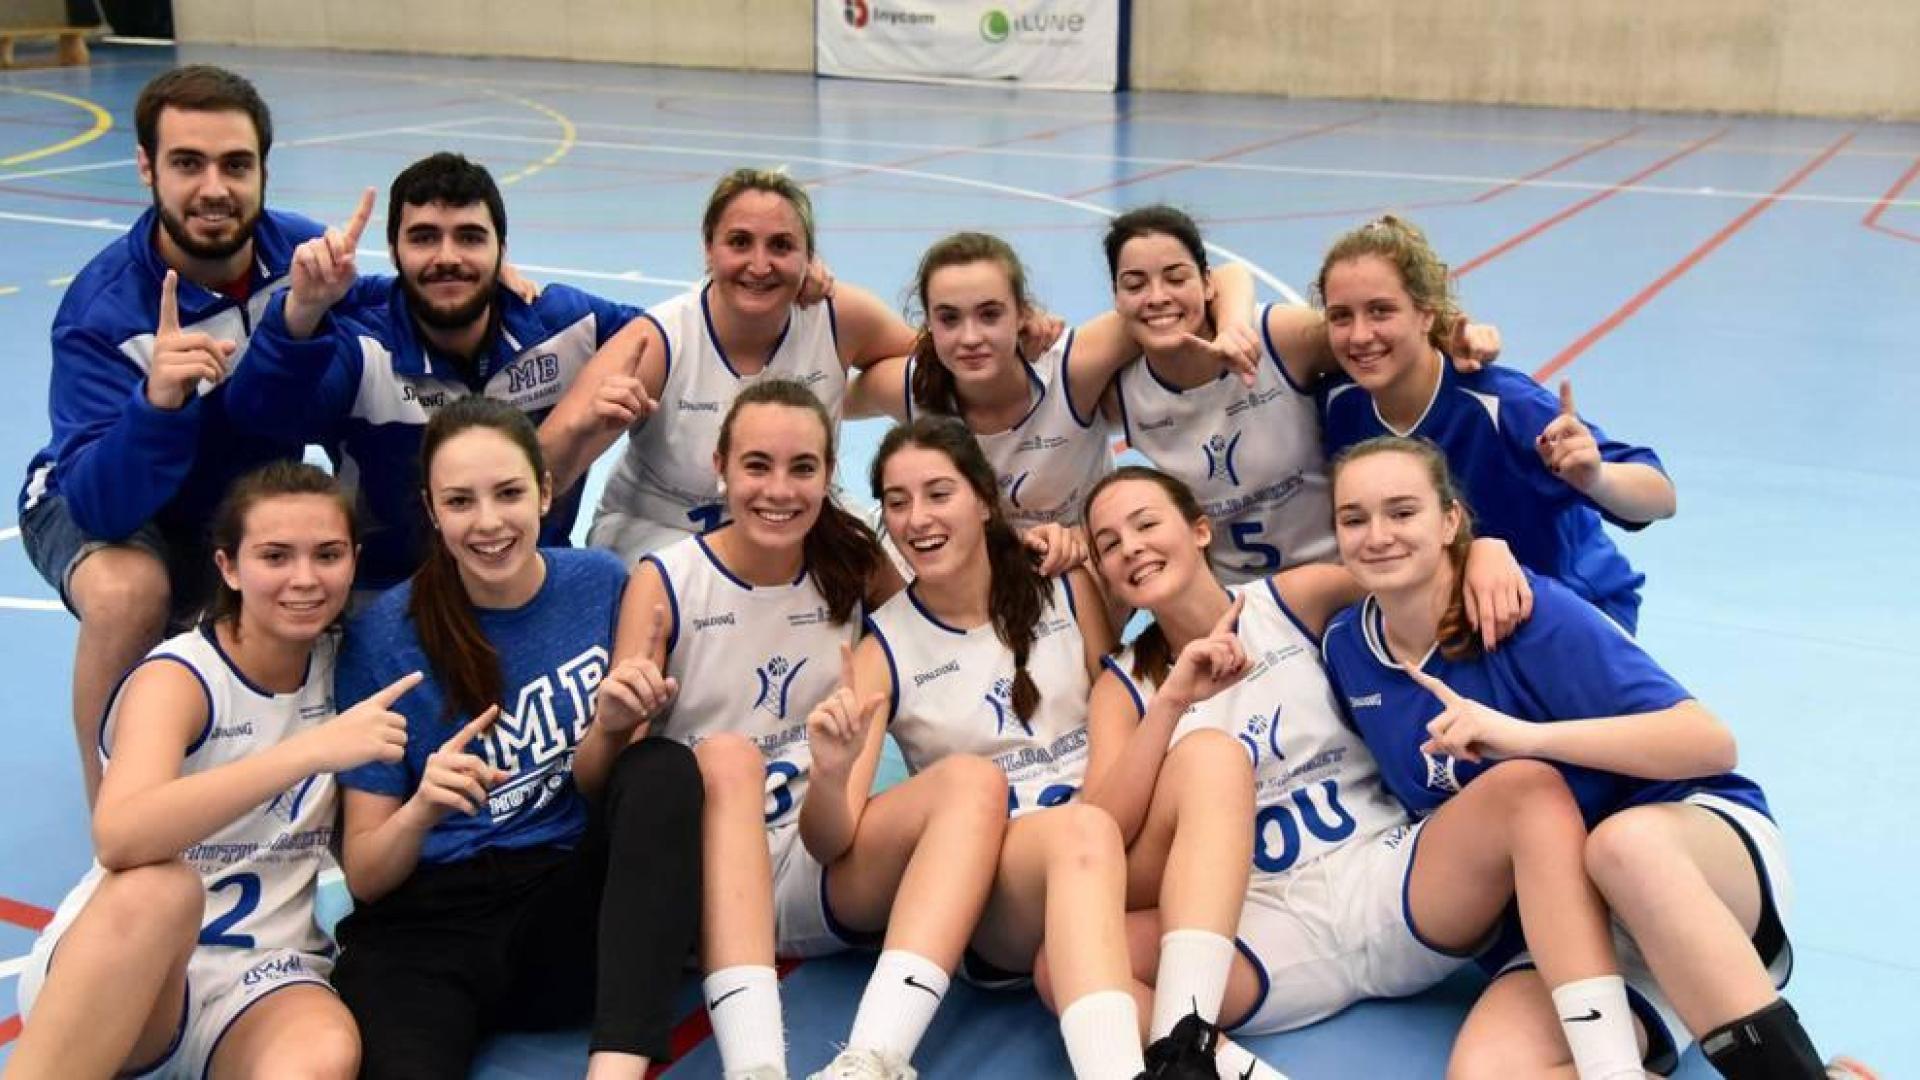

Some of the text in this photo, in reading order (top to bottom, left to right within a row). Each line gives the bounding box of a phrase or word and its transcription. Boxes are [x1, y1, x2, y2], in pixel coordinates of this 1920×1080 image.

[505, 353, 561, 393] MB
[1229, 521, 1281, 570] 5
[914, 659, 961, 688] SPALDING
[197, 871, 262, 950] 2
